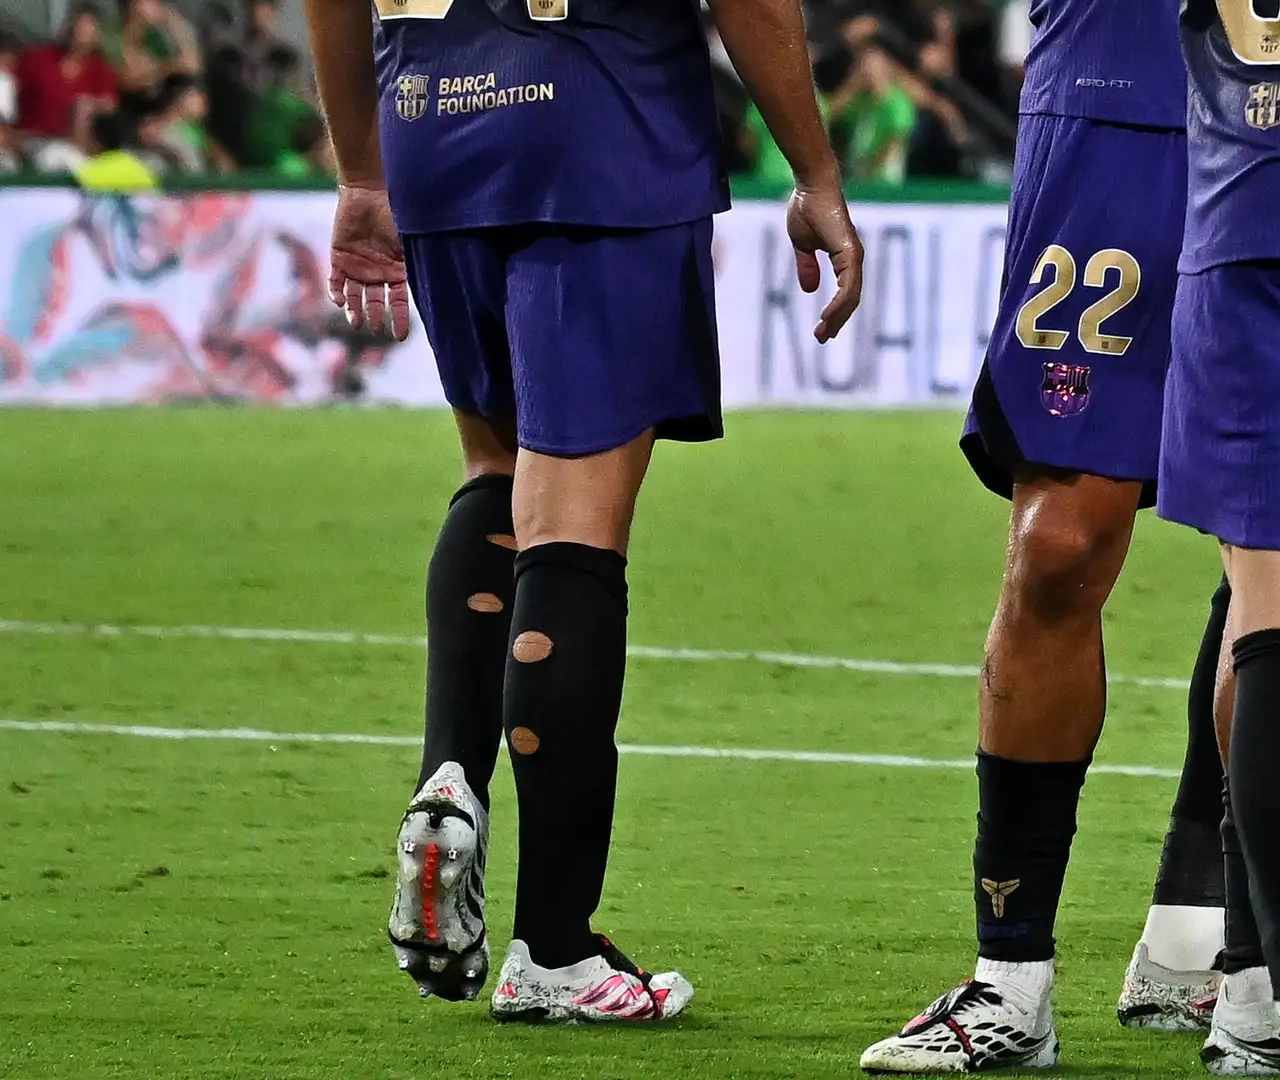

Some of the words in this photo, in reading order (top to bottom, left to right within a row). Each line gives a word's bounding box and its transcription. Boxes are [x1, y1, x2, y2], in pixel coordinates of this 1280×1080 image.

[436, 82, 554, 116] FOUNDATION
[437, 72, 496, 95] BARÇA
[1015, 244, 1141, 356] 22
